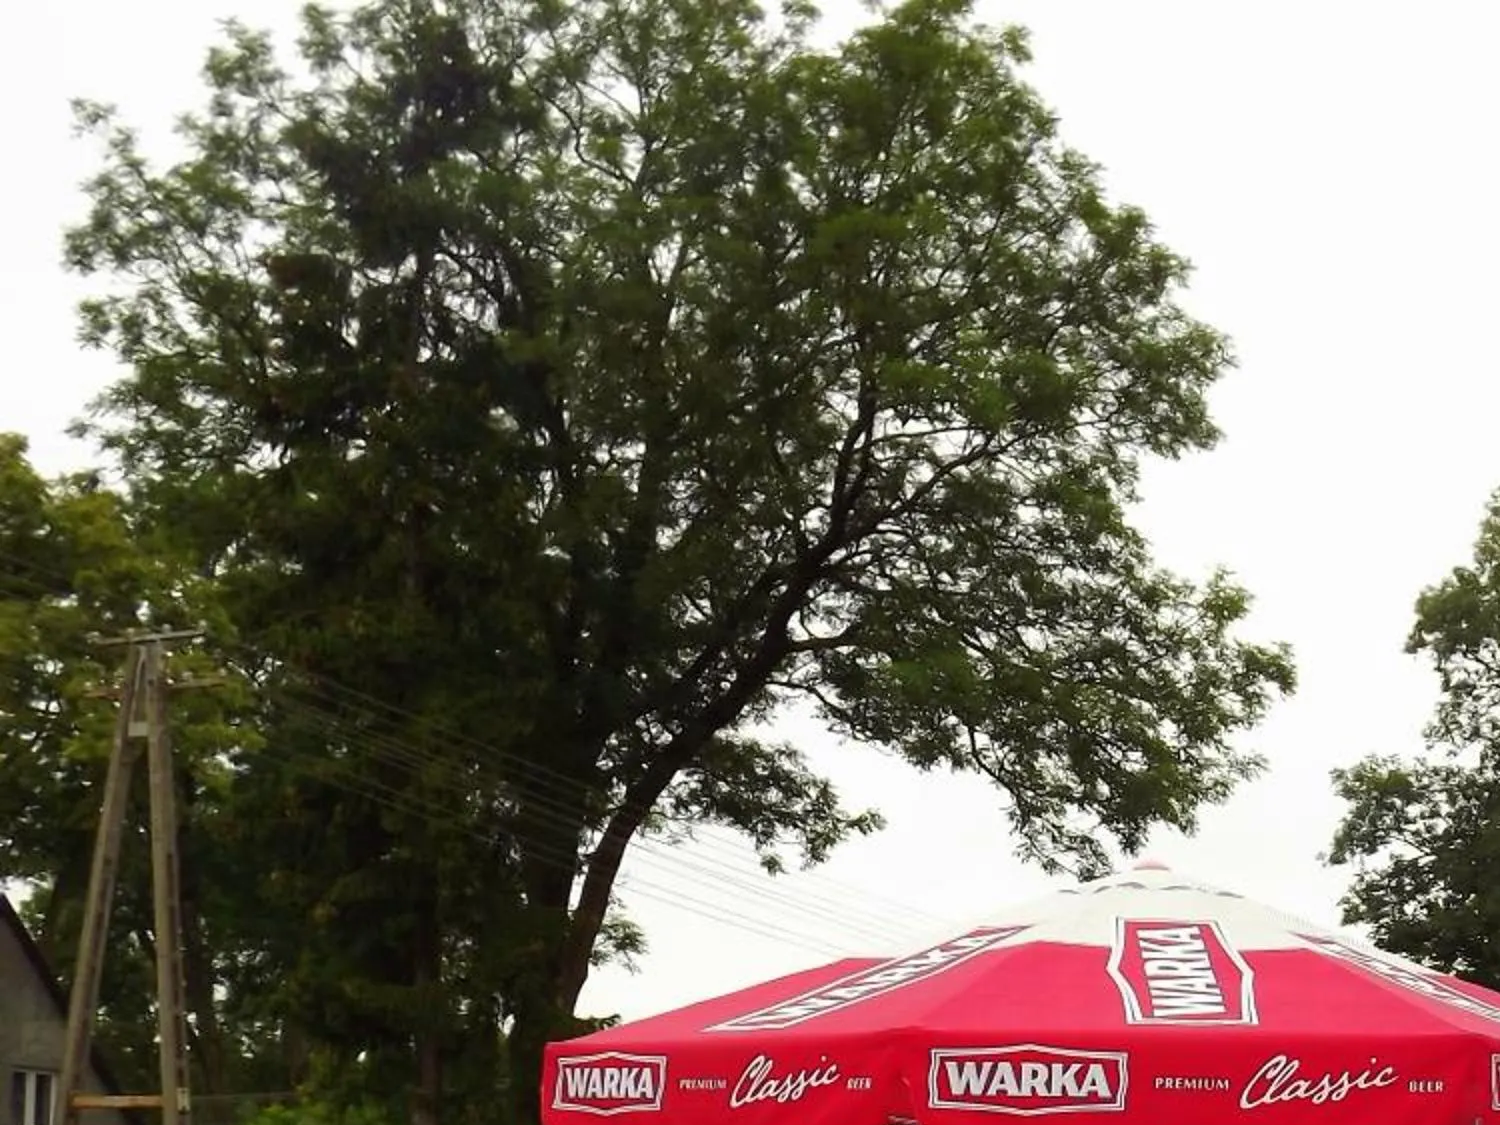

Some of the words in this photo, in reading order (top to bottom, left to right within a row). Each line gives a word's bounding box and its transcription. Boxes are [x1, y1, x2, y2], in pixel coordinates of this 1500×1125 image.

[1136, 925, 1227, 1017] WARKA
[566, 1067, 654, 1099] WARKA
[680, 1079, 727, 1090] PREMIUM
[730, 1055, 840, 1108] Classic
[945, 1061, 1112, 1098] WARKA
[1155, 1077, 1229, 1091] PREMIUM
[1240, 1055, 1399, 1109] Classic
[1409, 1081, 1444, 1093] BEER
